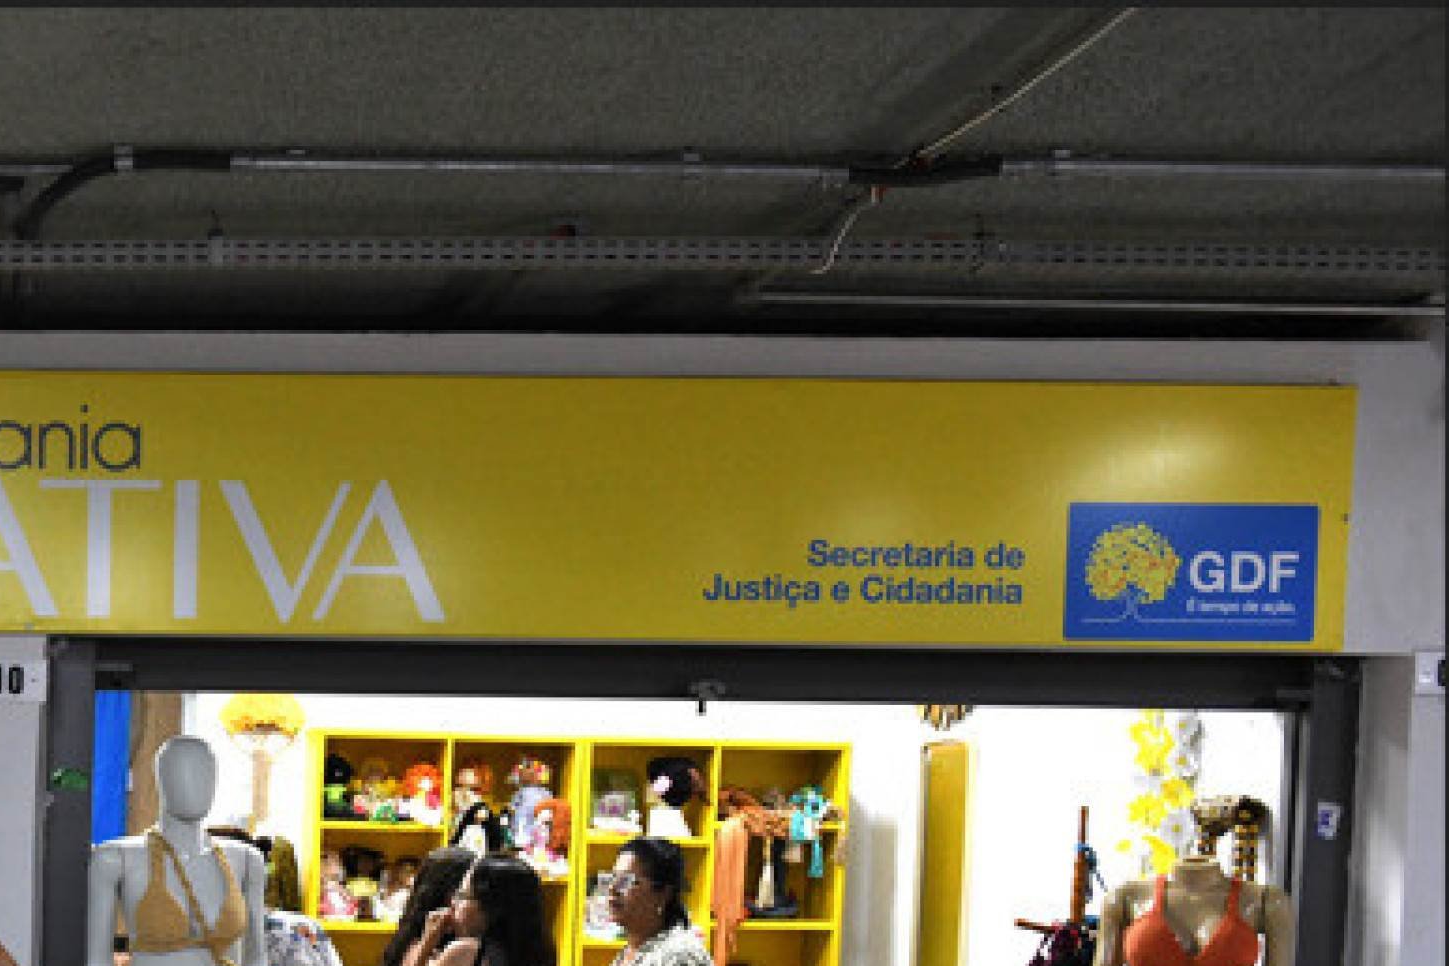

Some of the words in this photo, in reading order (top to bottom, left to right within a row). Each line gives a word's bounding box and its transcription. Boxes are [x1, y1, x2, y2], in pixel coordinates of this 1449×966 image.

[807, 539, 975, 568] Secretaria
[983, 540, 1025, 569] de
[1190, 551, 1299, 592] GDF
[703, 573, 820, 608] Justiça
[830, 580, 850, 603] e
[860, 576, 1022, 604] Cidadania
